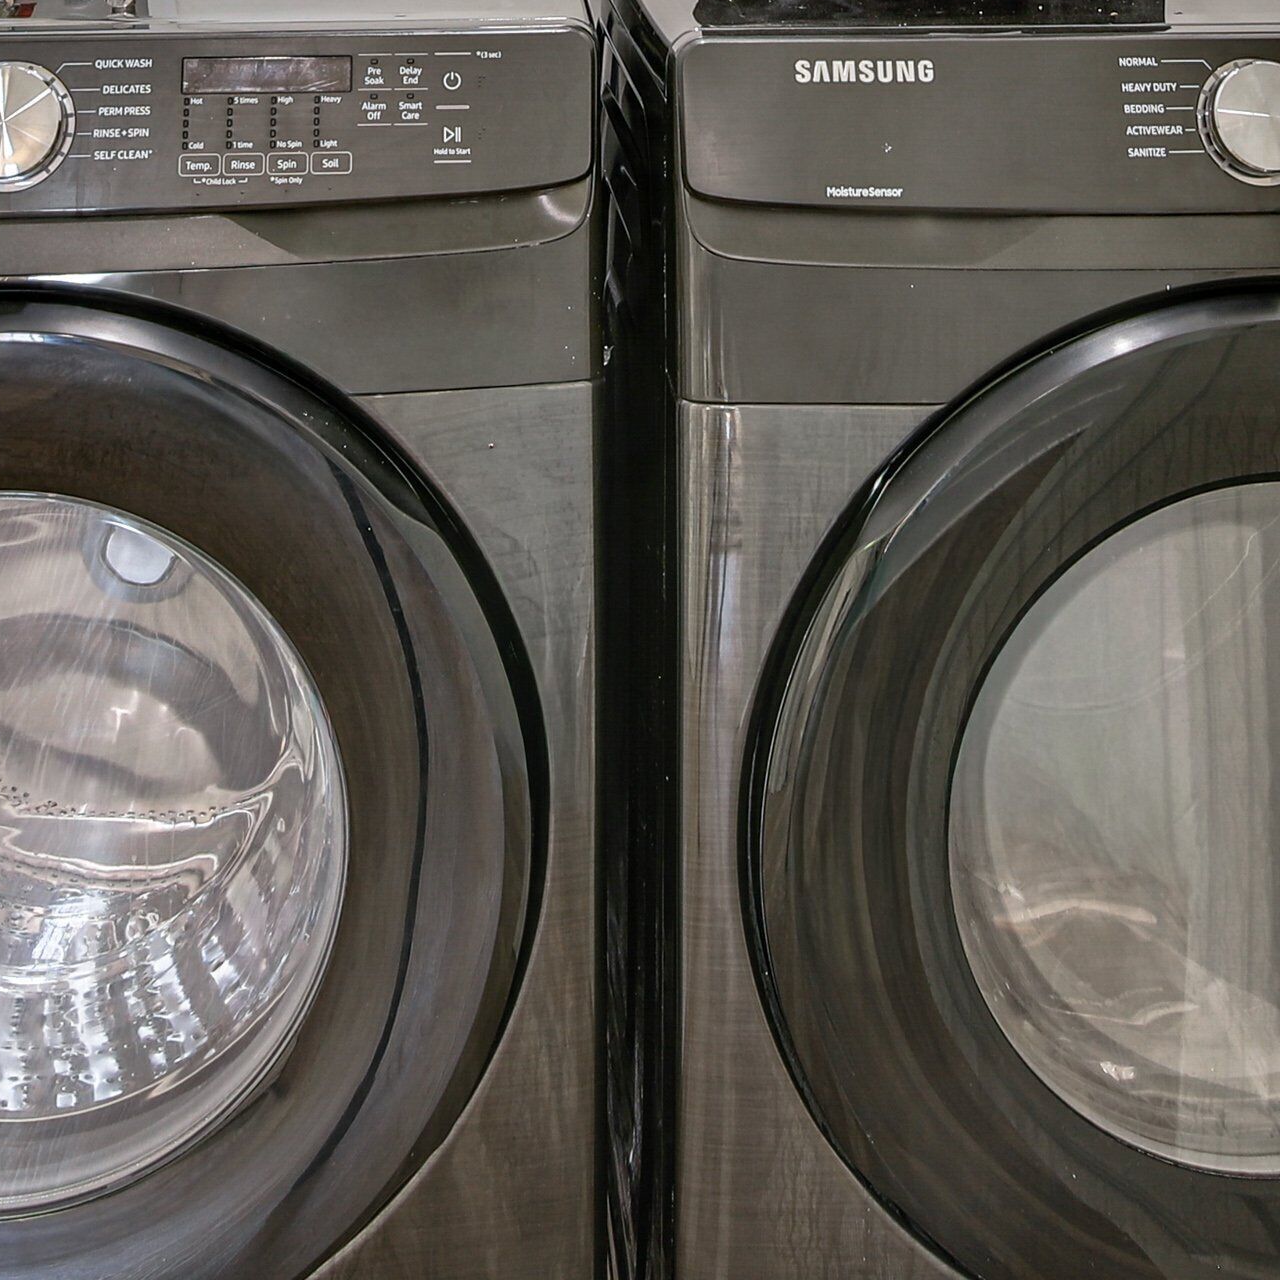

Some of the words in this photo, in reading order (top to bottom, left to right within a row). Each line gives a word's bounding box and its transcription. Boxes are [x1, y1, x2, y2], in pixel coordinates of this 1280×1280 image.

[95, 59, 123, 70] QUICK
[125, 59, 152, 68] WASH
[1119, 57, 1158, 66] NORMAL
[368, 67, 381, 75] Pre
[400, 66, 422, 77] Delay
[794, 60, 934, 83] SAMSUNG
[364, 76, 384, 85] Soak
[403, 76, 418, 84] End
[103, 84, 151, 94] DELICATES
[1121, 83, 1151, 92] HEAVY
[1153, 82, 1177, 92] DUTY
[277, 96, 293, 105] High
[98, 107, 123, 116] PERM
[124, 106, 150, 115] PRESS
[362, 102, 386, 110] Alarm
[399, 102, 422, 110] Smart
[1124, 104, 1164, 114] BEDDING
[367, 111, 381, 120] Off
[402, 111, 420, 120] Care
[1126, 125, 1183, 135] ACTIVEWEAR
[287, 140, 302, 151] Spin
[320, 140, 338, 148] Light
[94, 150, 116, 160] SELF
[1128, 148, 1166, 157] SANITIZE
[186, 161, 212, 172] Temp.
[231, 160, 255, 170] Rinse
[277, 159, 296, 170] Spin
[322, 158, 339, 168] Soil
[288, 176, 303, 184] Only
